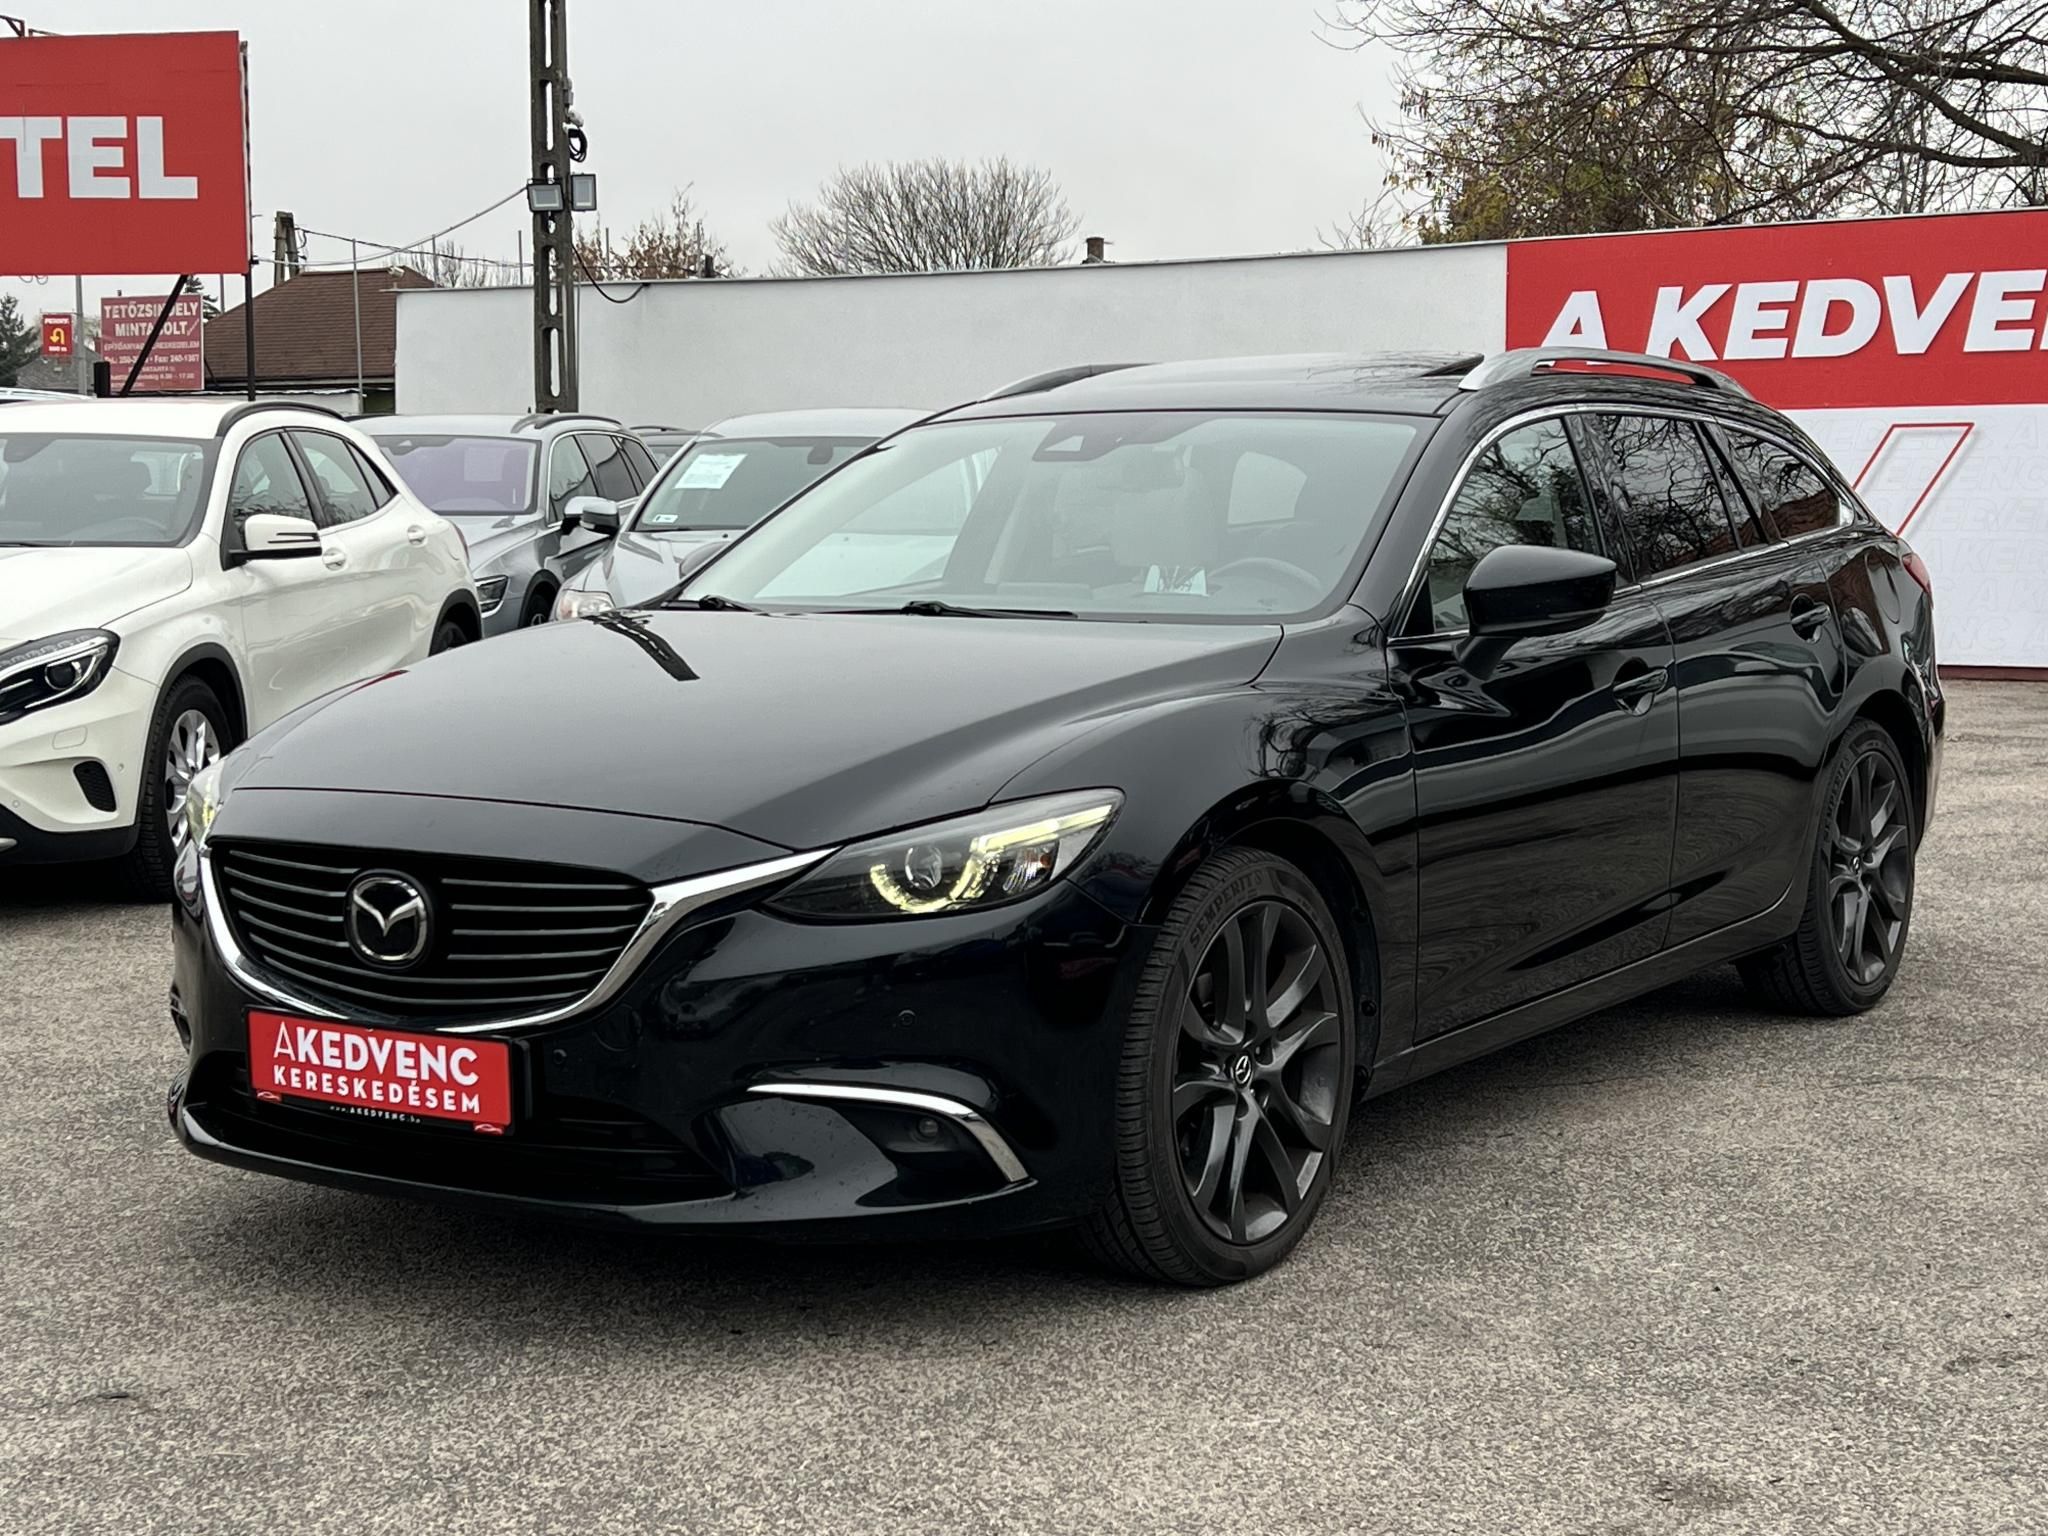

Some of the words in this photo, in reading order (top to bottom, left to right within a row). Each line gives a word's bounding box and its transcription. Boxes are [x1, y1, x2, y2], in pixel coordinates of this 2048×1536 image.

[115, 321, 188, 336] MINTAOLT
[1535, 290, 1609, 366] A
[1645, 269, 2048, 362] KEDVE
[273, 1065, 480, 1114] KERESKEDÉSEM
